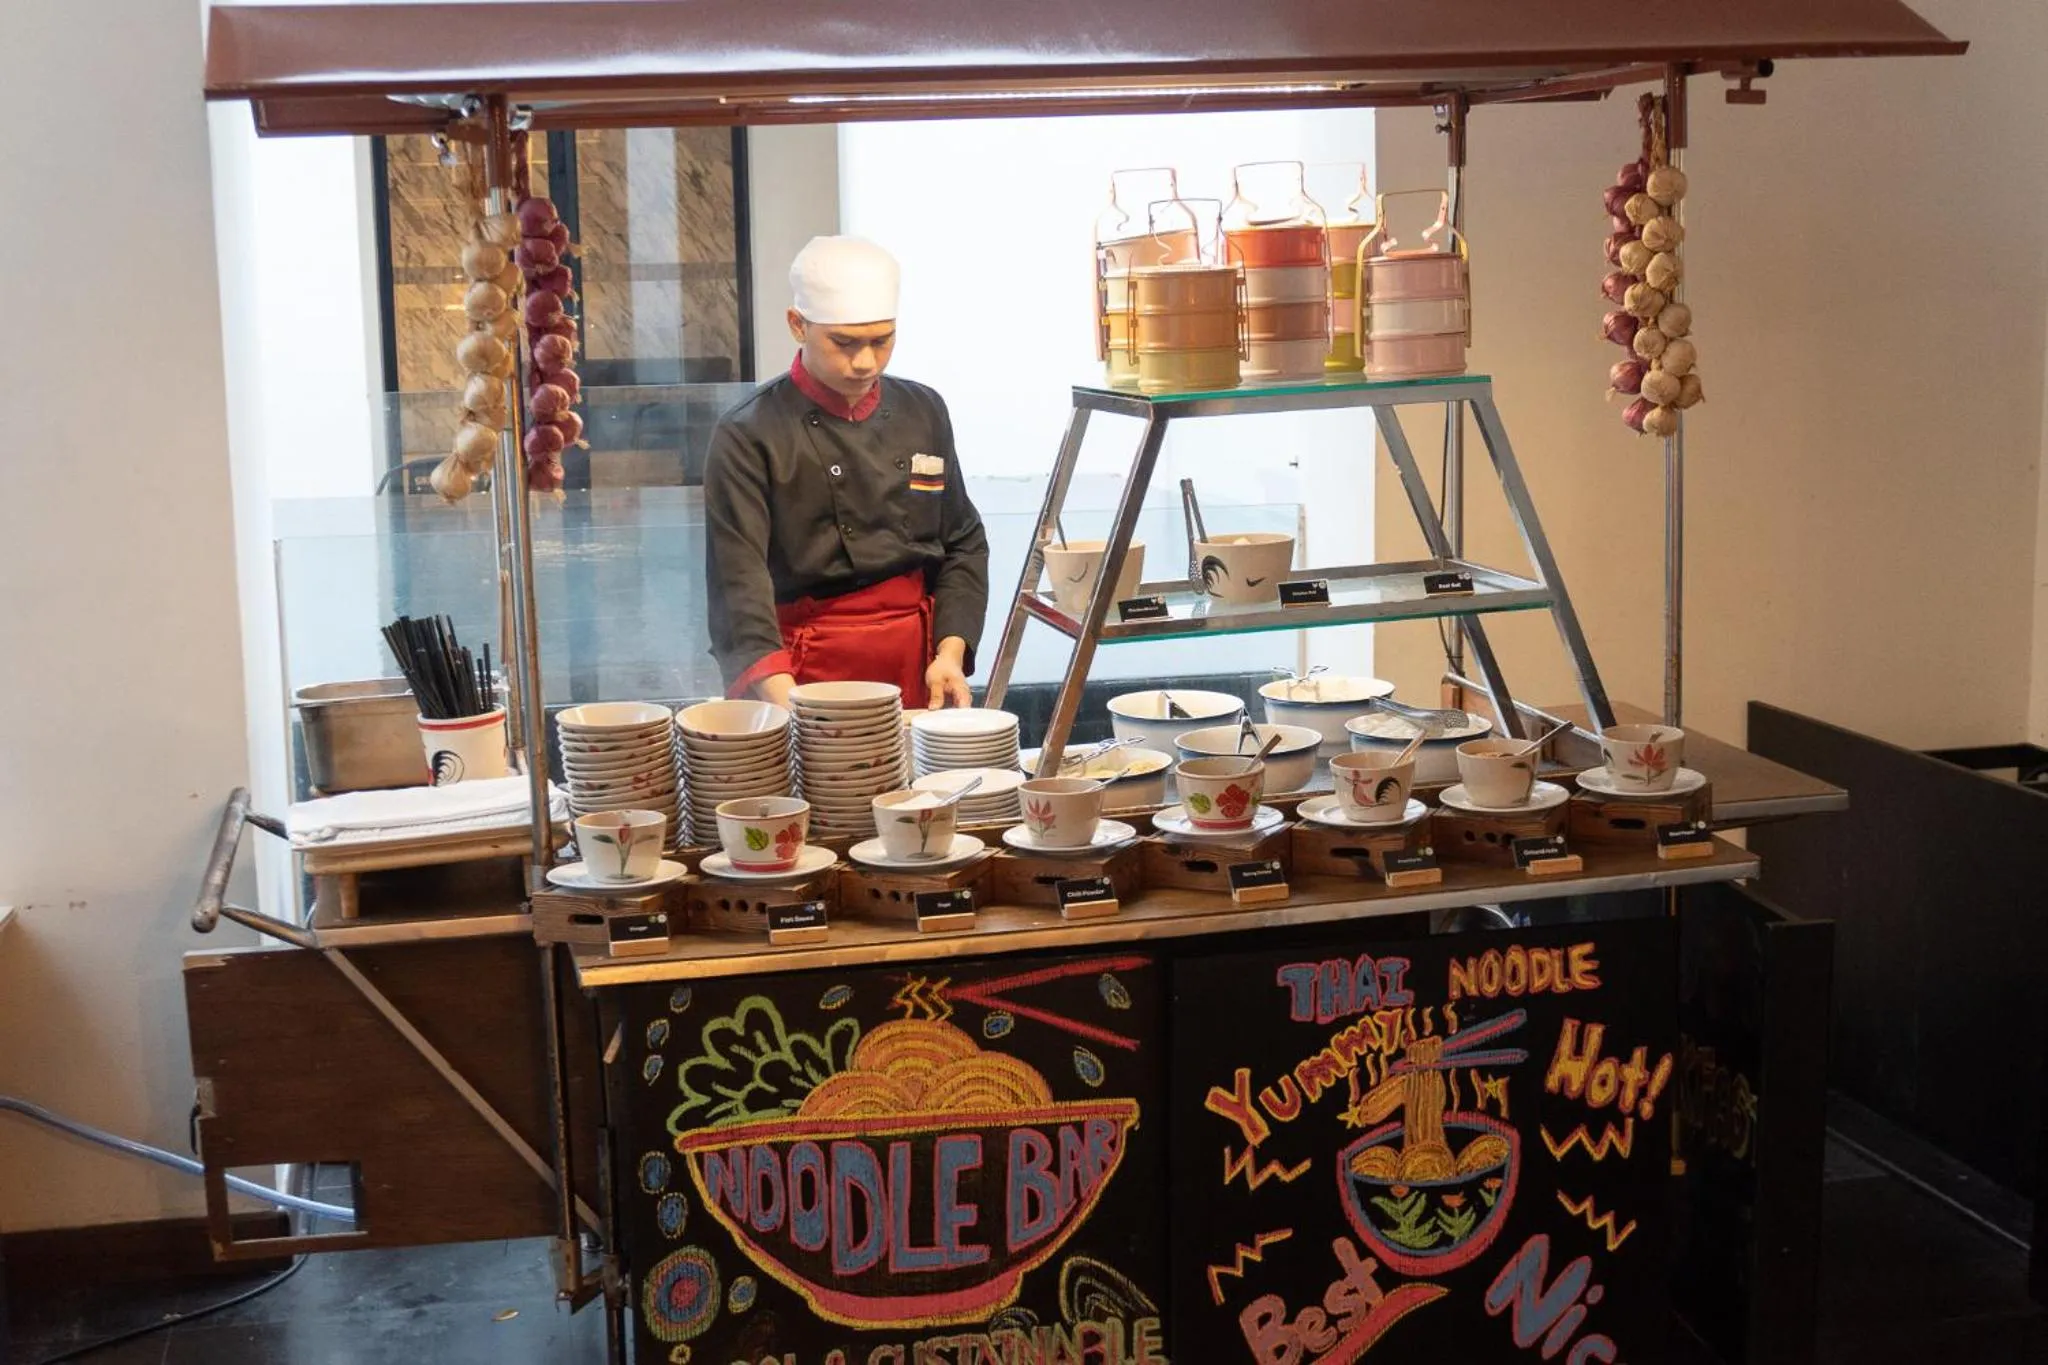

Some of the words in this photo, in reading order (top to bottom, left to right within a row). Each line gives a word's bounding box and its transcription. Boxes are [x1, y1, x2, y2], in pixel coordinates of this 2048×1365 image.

[1277, 953, 1415, 1024] THAI
[1449, 942, 1603, 1000] NOODLE
[704, 1133, 990, 1277] NOODLE
[1007, 1119, 1121, 1252] BAR
[1239, 1236, 1385, 1365] Best
[1484, 1233, 1628, 1365] Nic
